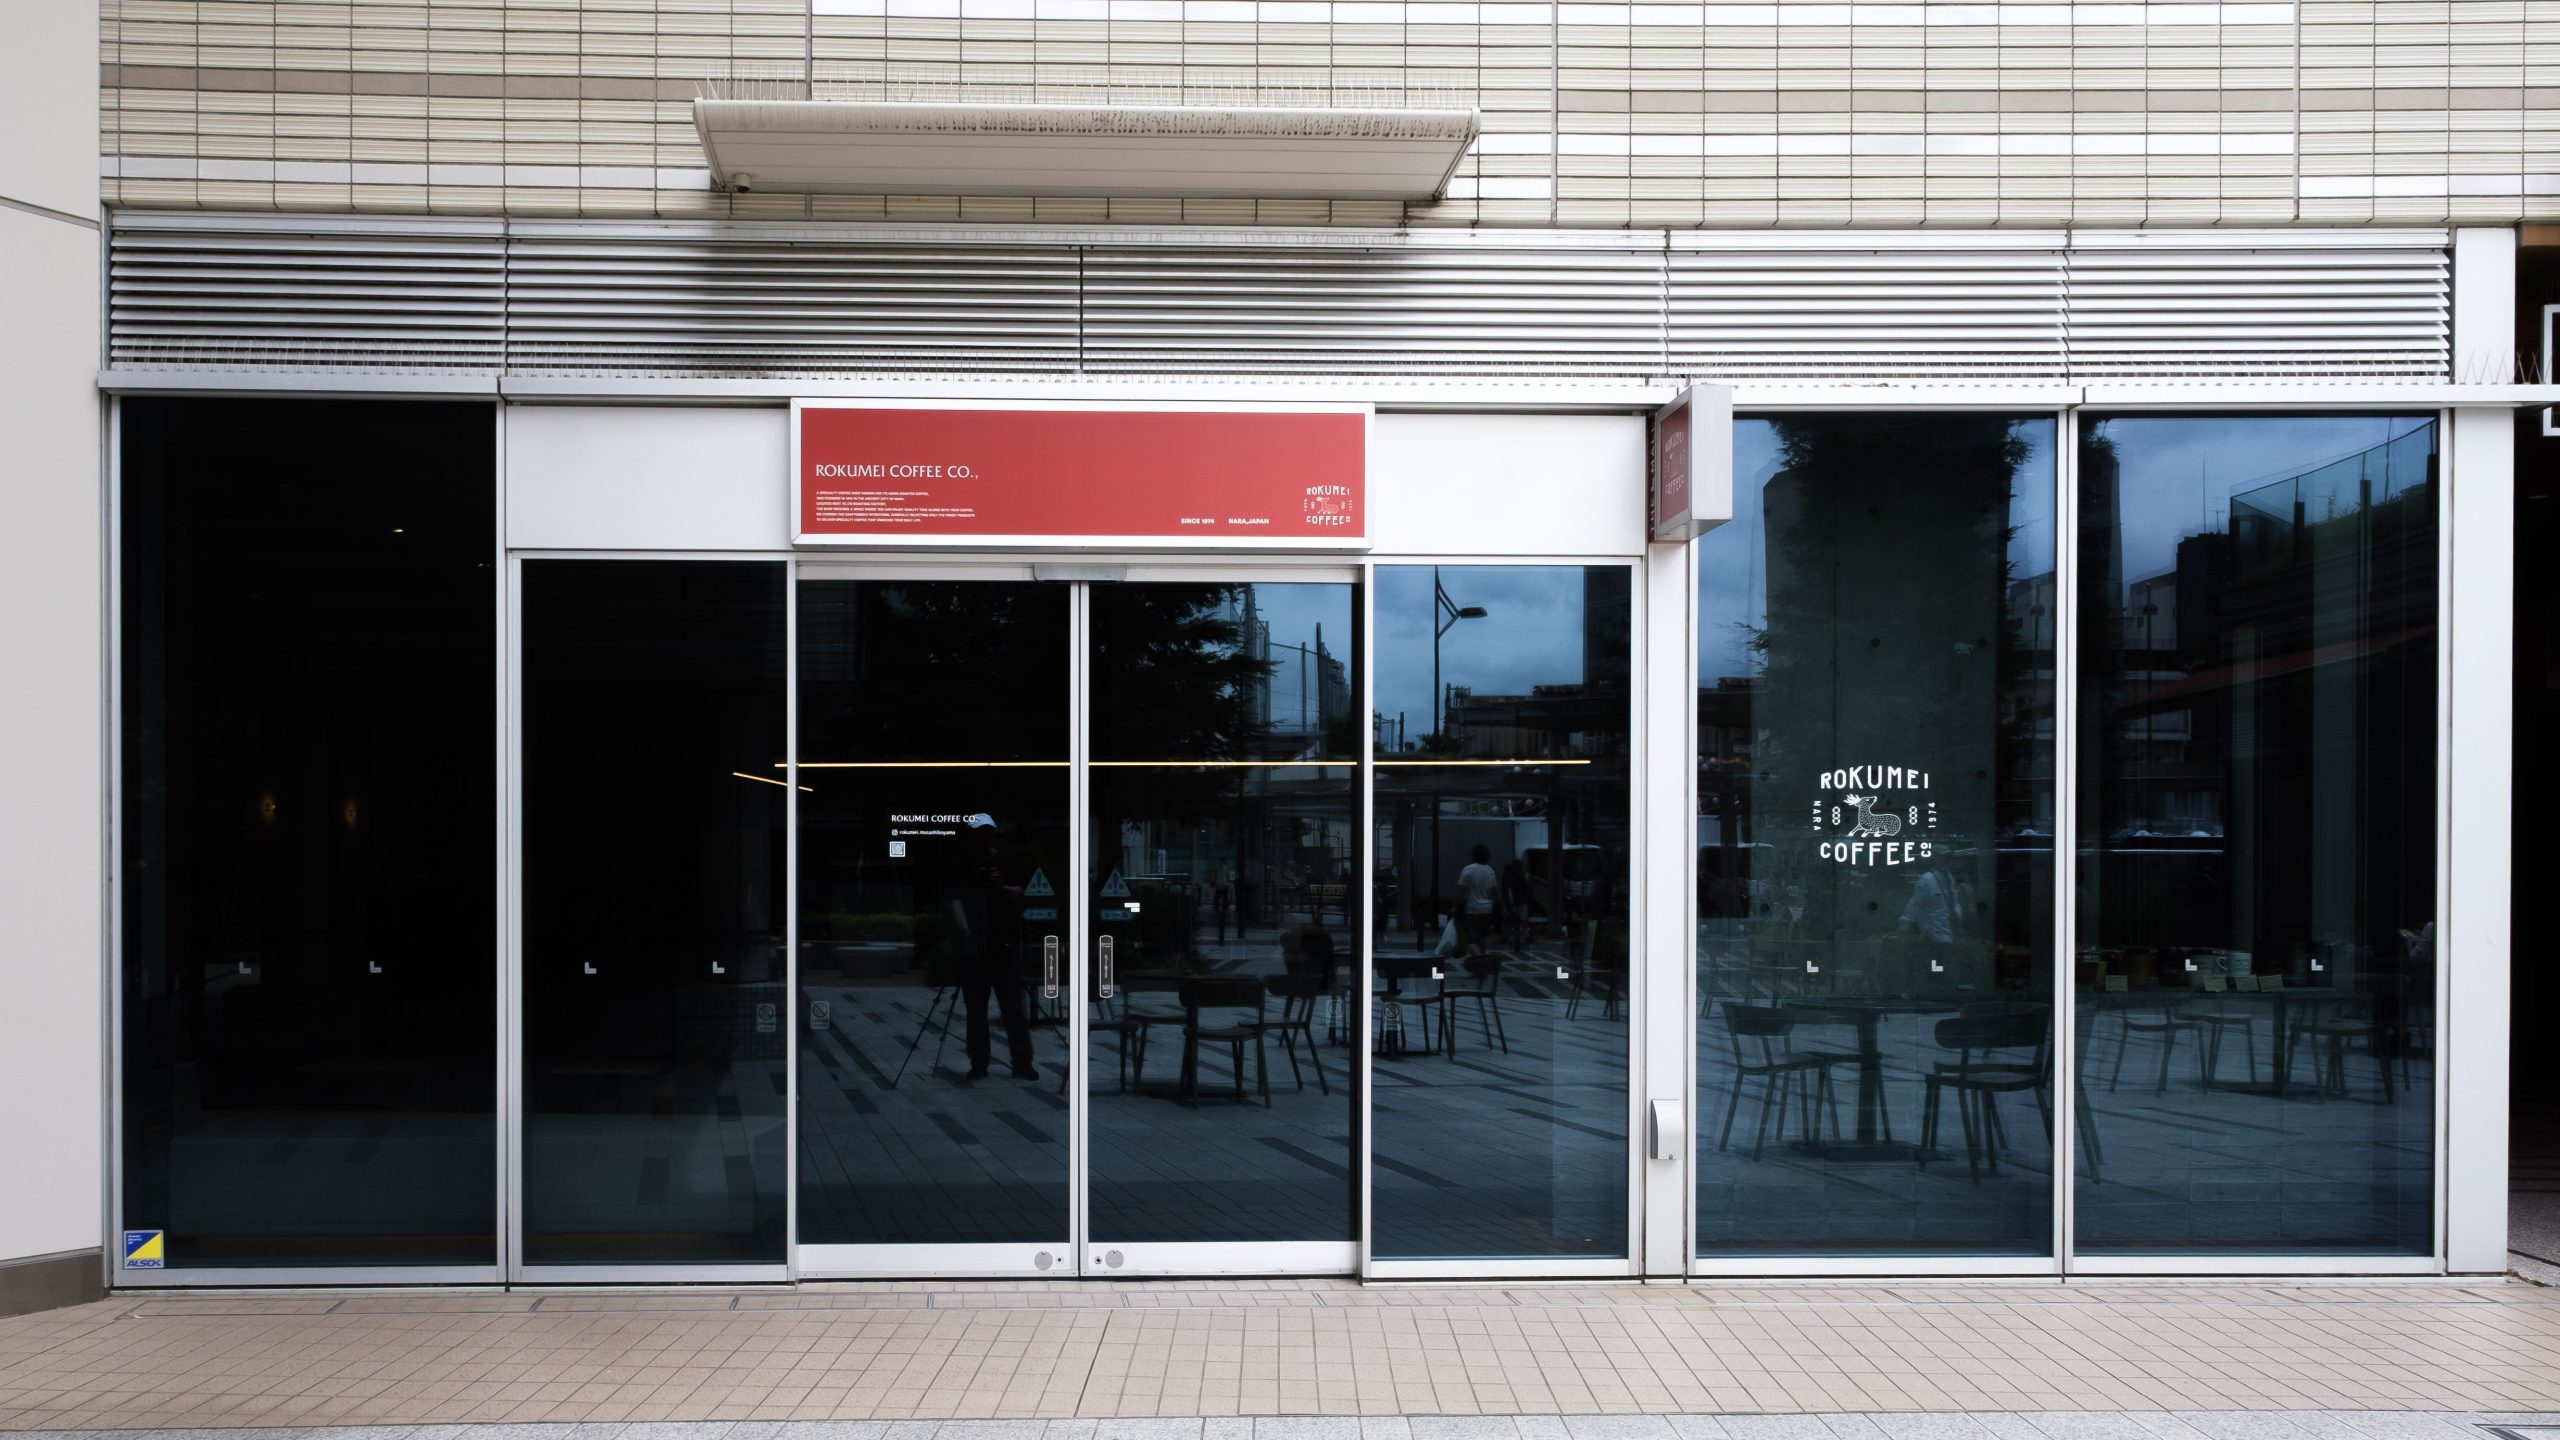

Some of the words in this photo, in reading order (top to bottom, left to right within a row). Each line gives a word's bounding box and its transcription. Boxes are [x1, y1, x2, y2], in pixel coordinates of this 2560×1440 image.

[815, 464, 885, 477] ROKUMEI
[889, 465, 943, 478] COFFEE
[1306, 485, 1350, 496] ROKUMEI
[1181, 517, 1200, 525] SINCE
[1306, 515, 1345, 526] COFFEE
[1820, 765, 1929, 789] ROKUMEI
[891, 814, 929, 823] ROKUMEI
[930, 814, 961, 823] COFFEE
[1812, 800, 1822, 831] NARA
[1928, 802, 1937, 828] 1974
[1820, 842, 1915, 866] COFFEE
